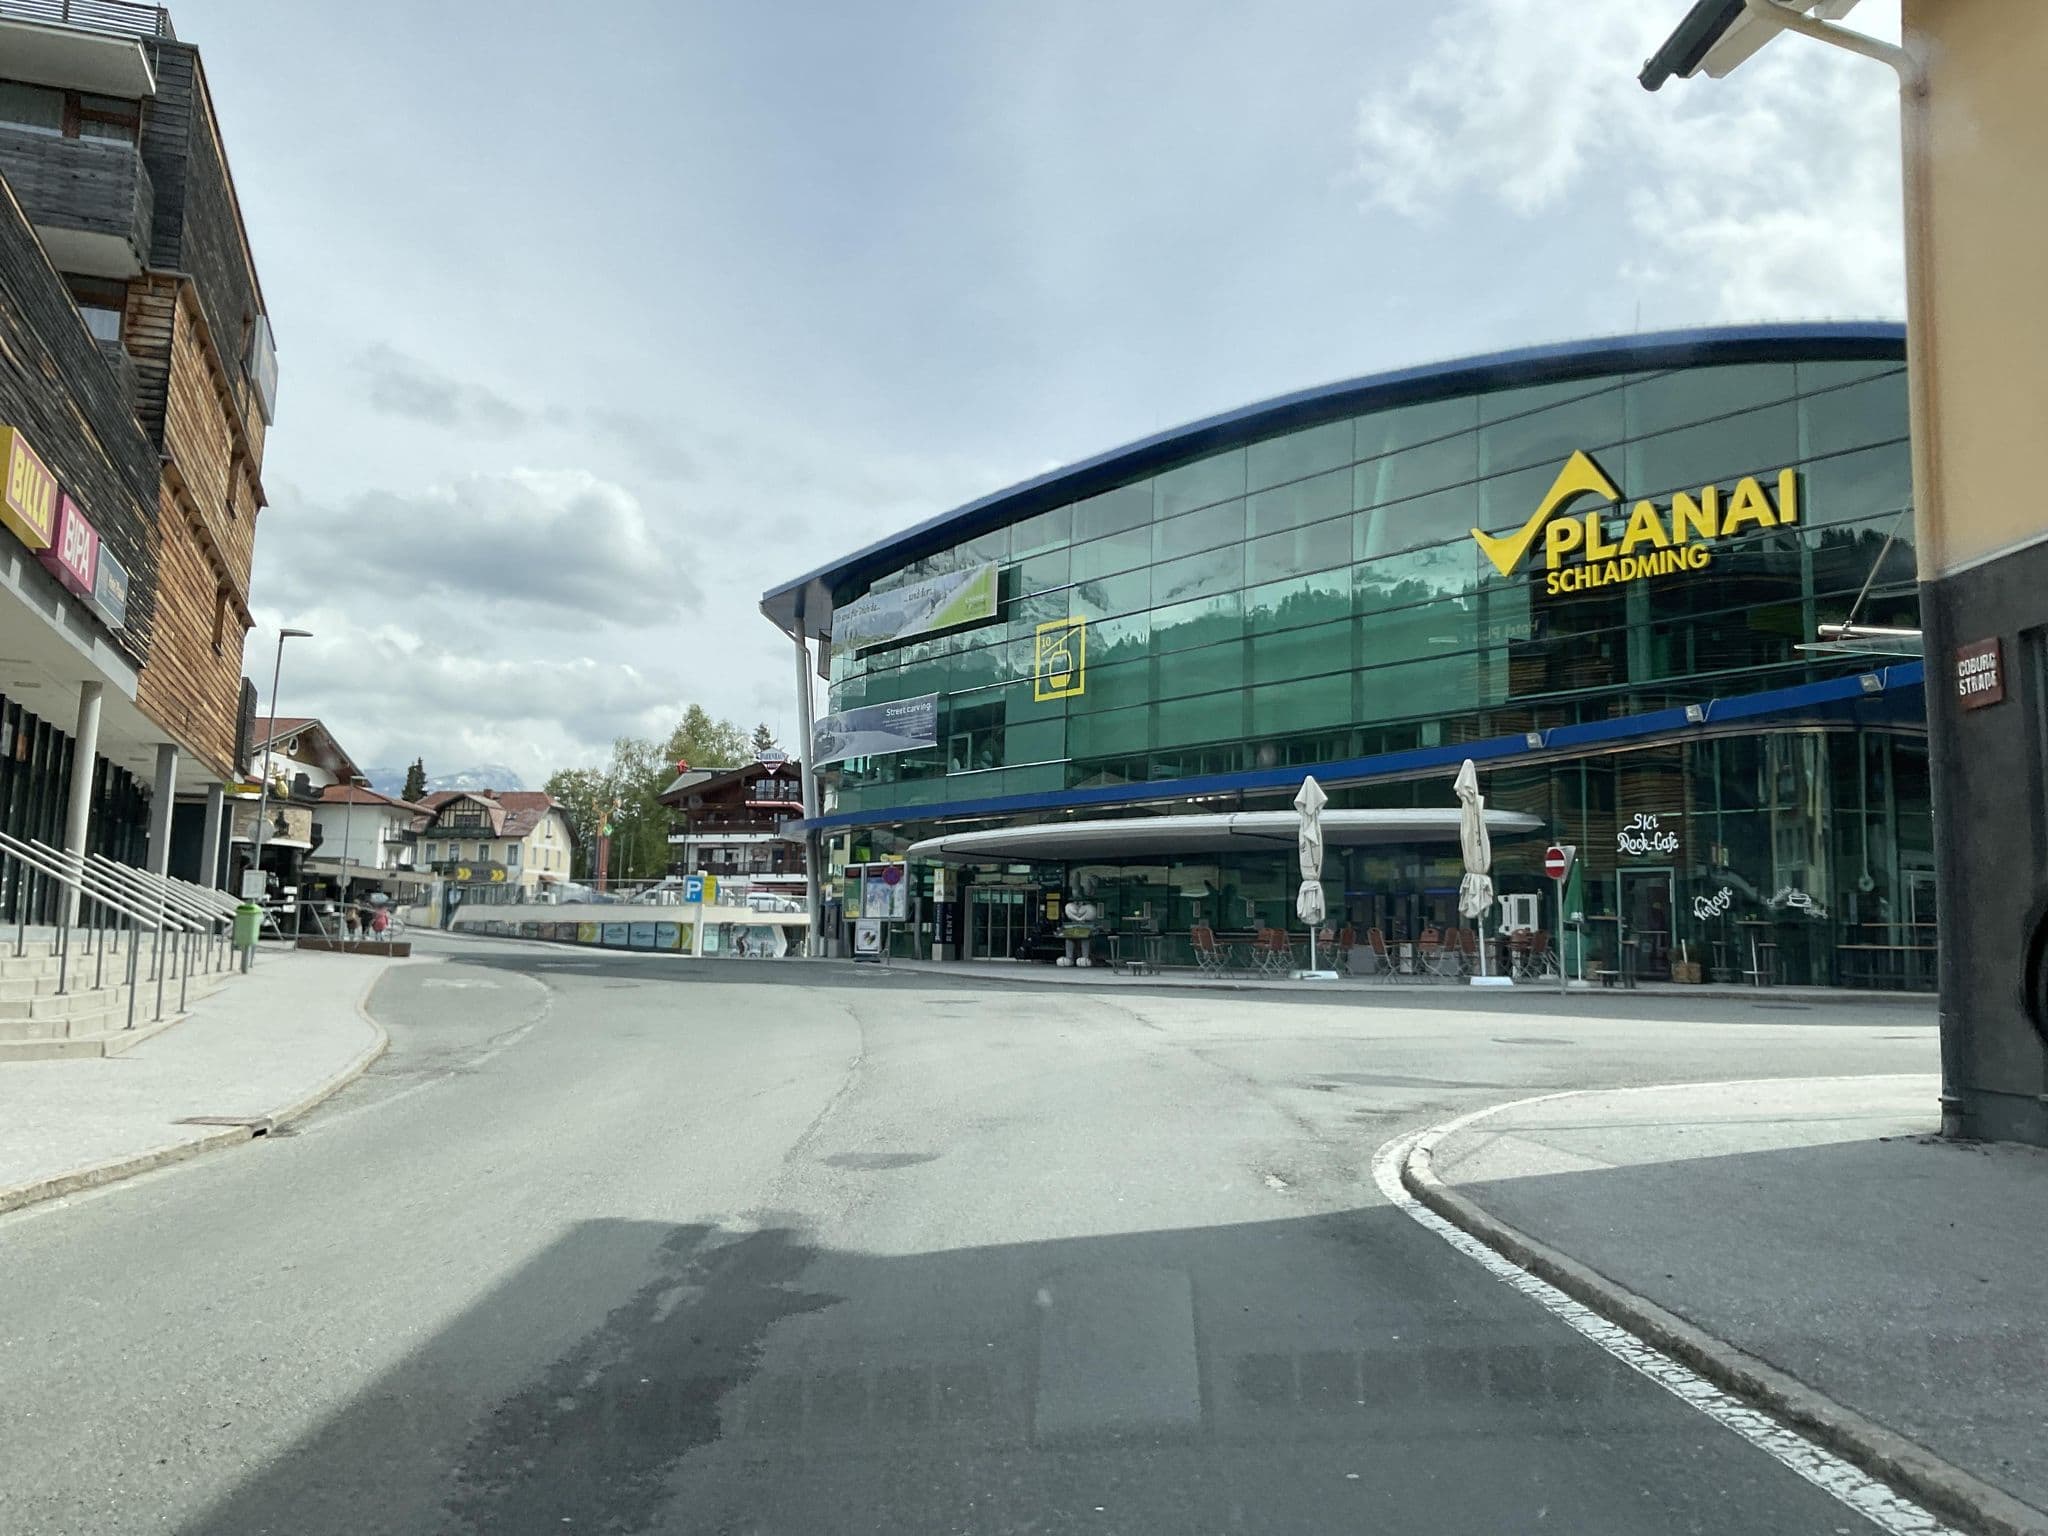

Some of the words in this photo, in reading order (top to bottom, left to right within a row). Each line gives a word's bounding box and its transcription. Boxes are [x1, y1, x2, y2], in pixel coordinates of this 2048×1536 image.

[11, 444, 50, 535] BILLA
[1545, 467, 1799, 570] PLANAI
[63, 508, 91, 582] BIPA
[1546, 542, 1711, 596] SCHLADMING
[1041, 636, 1051, 649] 10
[1958, 652, 1996, 677] COBURG
[885, 706, 906, 717] Street
[686, 880, 702, 899] P
[1693, 886, 1733, 921] Vintage
